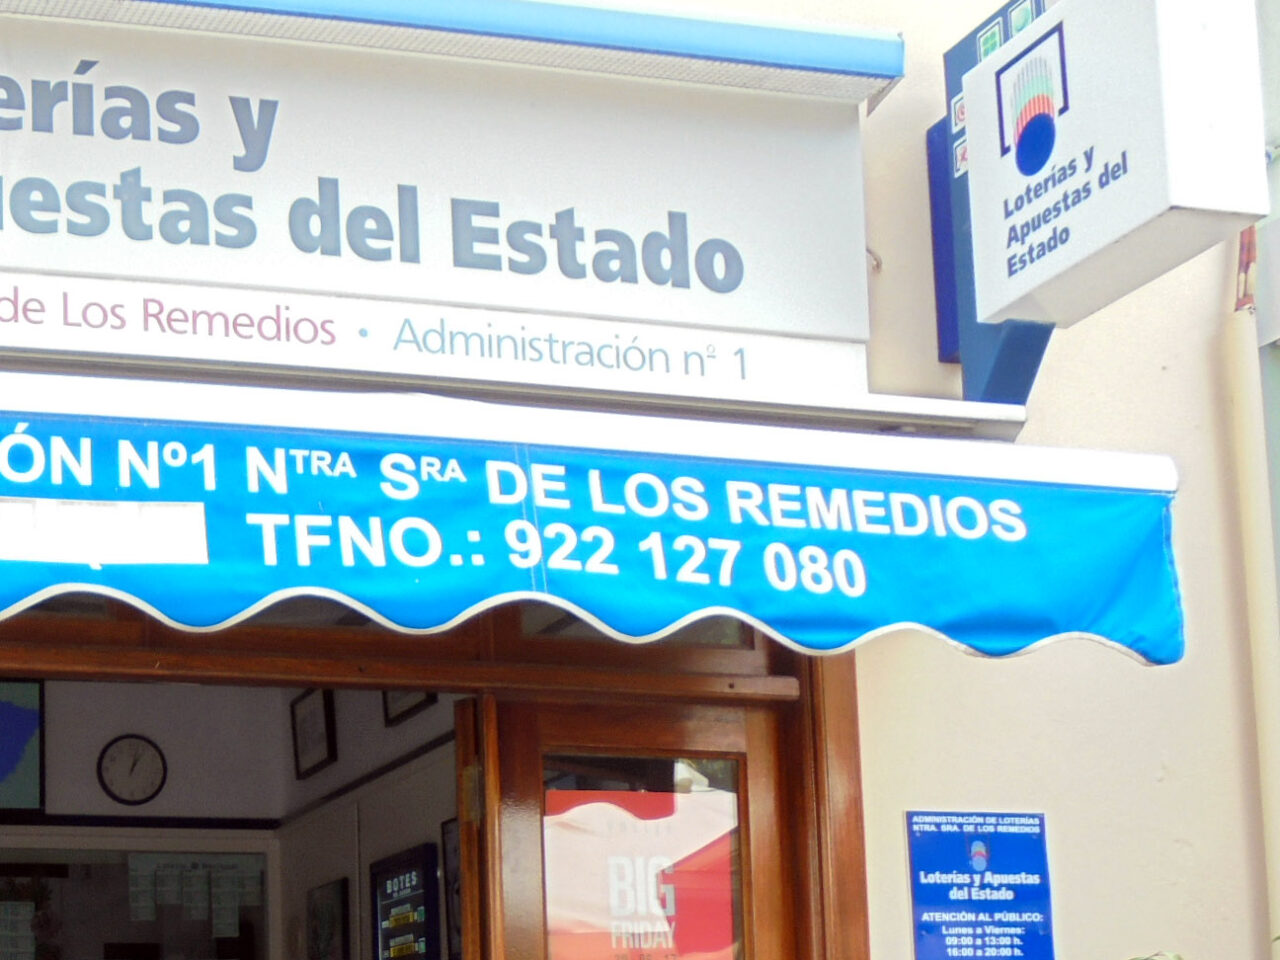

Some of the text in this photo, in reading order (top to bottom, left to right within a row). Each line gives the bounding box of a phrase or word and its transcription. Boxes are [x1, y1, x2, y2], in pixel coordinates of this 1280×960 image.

[229, 96, 279, 173] y
[1003, 146, 1095, 220] Loterías y
[1006, 151, 1129, 254] Apuestas del
[289, 178, 420, 263] del
[452, 199, 744, 294] Estado
[1007, 225, 1071, 279] Estado
[63, 292, 127, 330] Los
[143, 298, 337, 346] Remedios
[393, 317, 671, 374] Administración
[733, 348, 747, 380] 1
[247, 447, 357, 495] NTRA
[381, 453, 467, 501] SRA
[486, 461, 570, 510] DE
[589, 470, 709, 521] LOS
[727, 481, 1028, 542] REMEDIOS
[246, 514, 867, 598] TFNO.: 922 127 080
[912, 815, 985, 825] ADMINISTRACIÓN
[986, 816, 998, 825] DE
[977, 825, 995, 833] LOS
[920, 870, 1041, 887] Loterías y Apuestas
[948, 886, 1015, 901] del Estado
[921, 910, 1044, 922] ATENCIÓN AL PÚBLICO:
[942, 925, 974, 935] Lunes
[984, 925, 1026, 935] Viernes:
[984, 936, 1012, 946] 13:00
